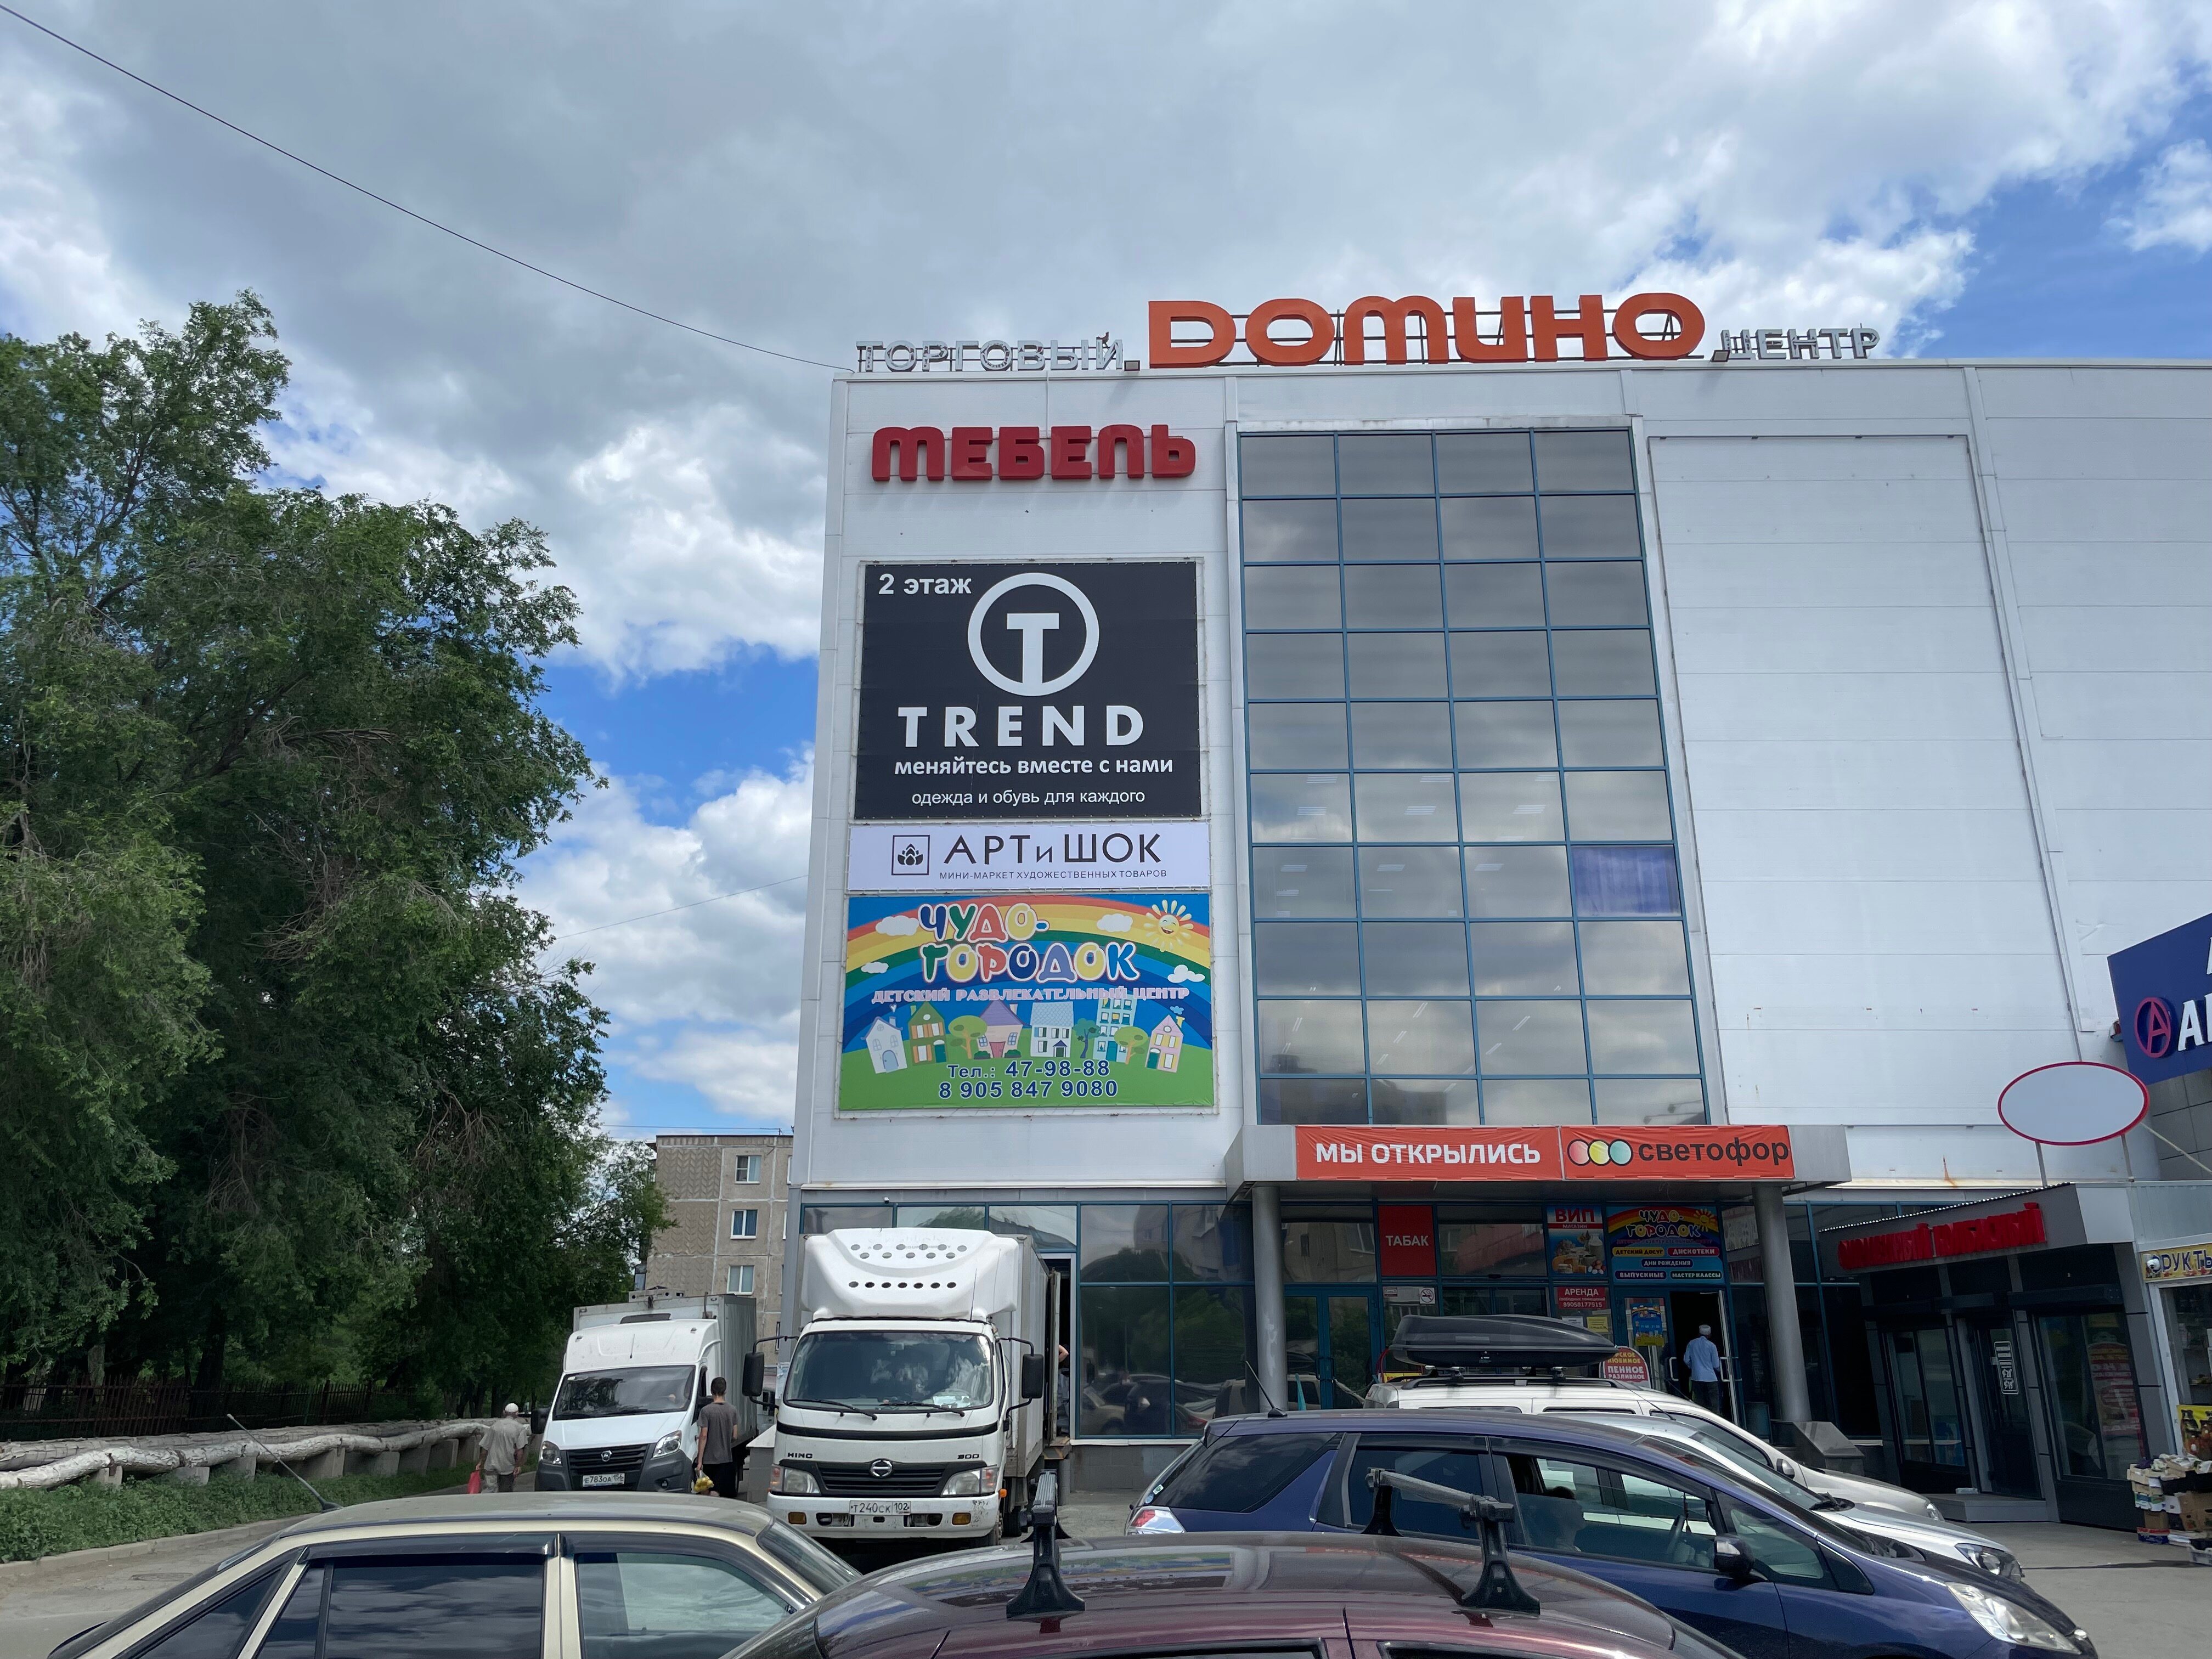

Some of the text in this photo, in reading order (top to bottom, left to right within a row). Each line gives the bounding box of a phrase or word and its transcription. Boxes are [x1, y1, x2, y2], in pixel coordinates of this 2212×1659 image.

[856, 331, 1123, 372] ТОРГОВЫЙ
[1721, 325, 1880, 360] ЦЕНТР
[872, 424, 1196, 482] МЕБЕЛЬ
[879, 574, 972, 595] 2 этаж
[898, 706, 1143, 747] TREND
[894, 755, 1173, 775] меняйтесь вместе с нами
[912, 790, 1145, 806] одежда и обувь для каждого
[940, 869, 1167, 879] МИНИ-МАРКЕТ ХУДОЖЕСТВЕННЫХ ТОВАРОВ
[919, 942, 1141, 983] ГОРОДОК
[871, 986, 1190, 1004] ДЕТСКИЙ РАЗВЛЕКАТЕЛЬНЫЙ ЦЕНТР
[1005, 1059, 1110, 1077] 47-98-88
[939, 1080, 1118, 1099] 8 905 847 9080
[1316, 1142, 1541, 1164] МЫ ОТКРЫЛИСЬ
[1638, 1137, 1788, 1167] светофор
[1555, 1209, 1595, 1222] ВИП
[1385, 1234, 1429, 1247] ТАБАК
[1626, 1224, 1701, 1238] ГОРОДОК
[1565, 1288, 1599, 1297] АРЕНДА
[1607, 1365, 1644, 1374] ПЕННОЕ
